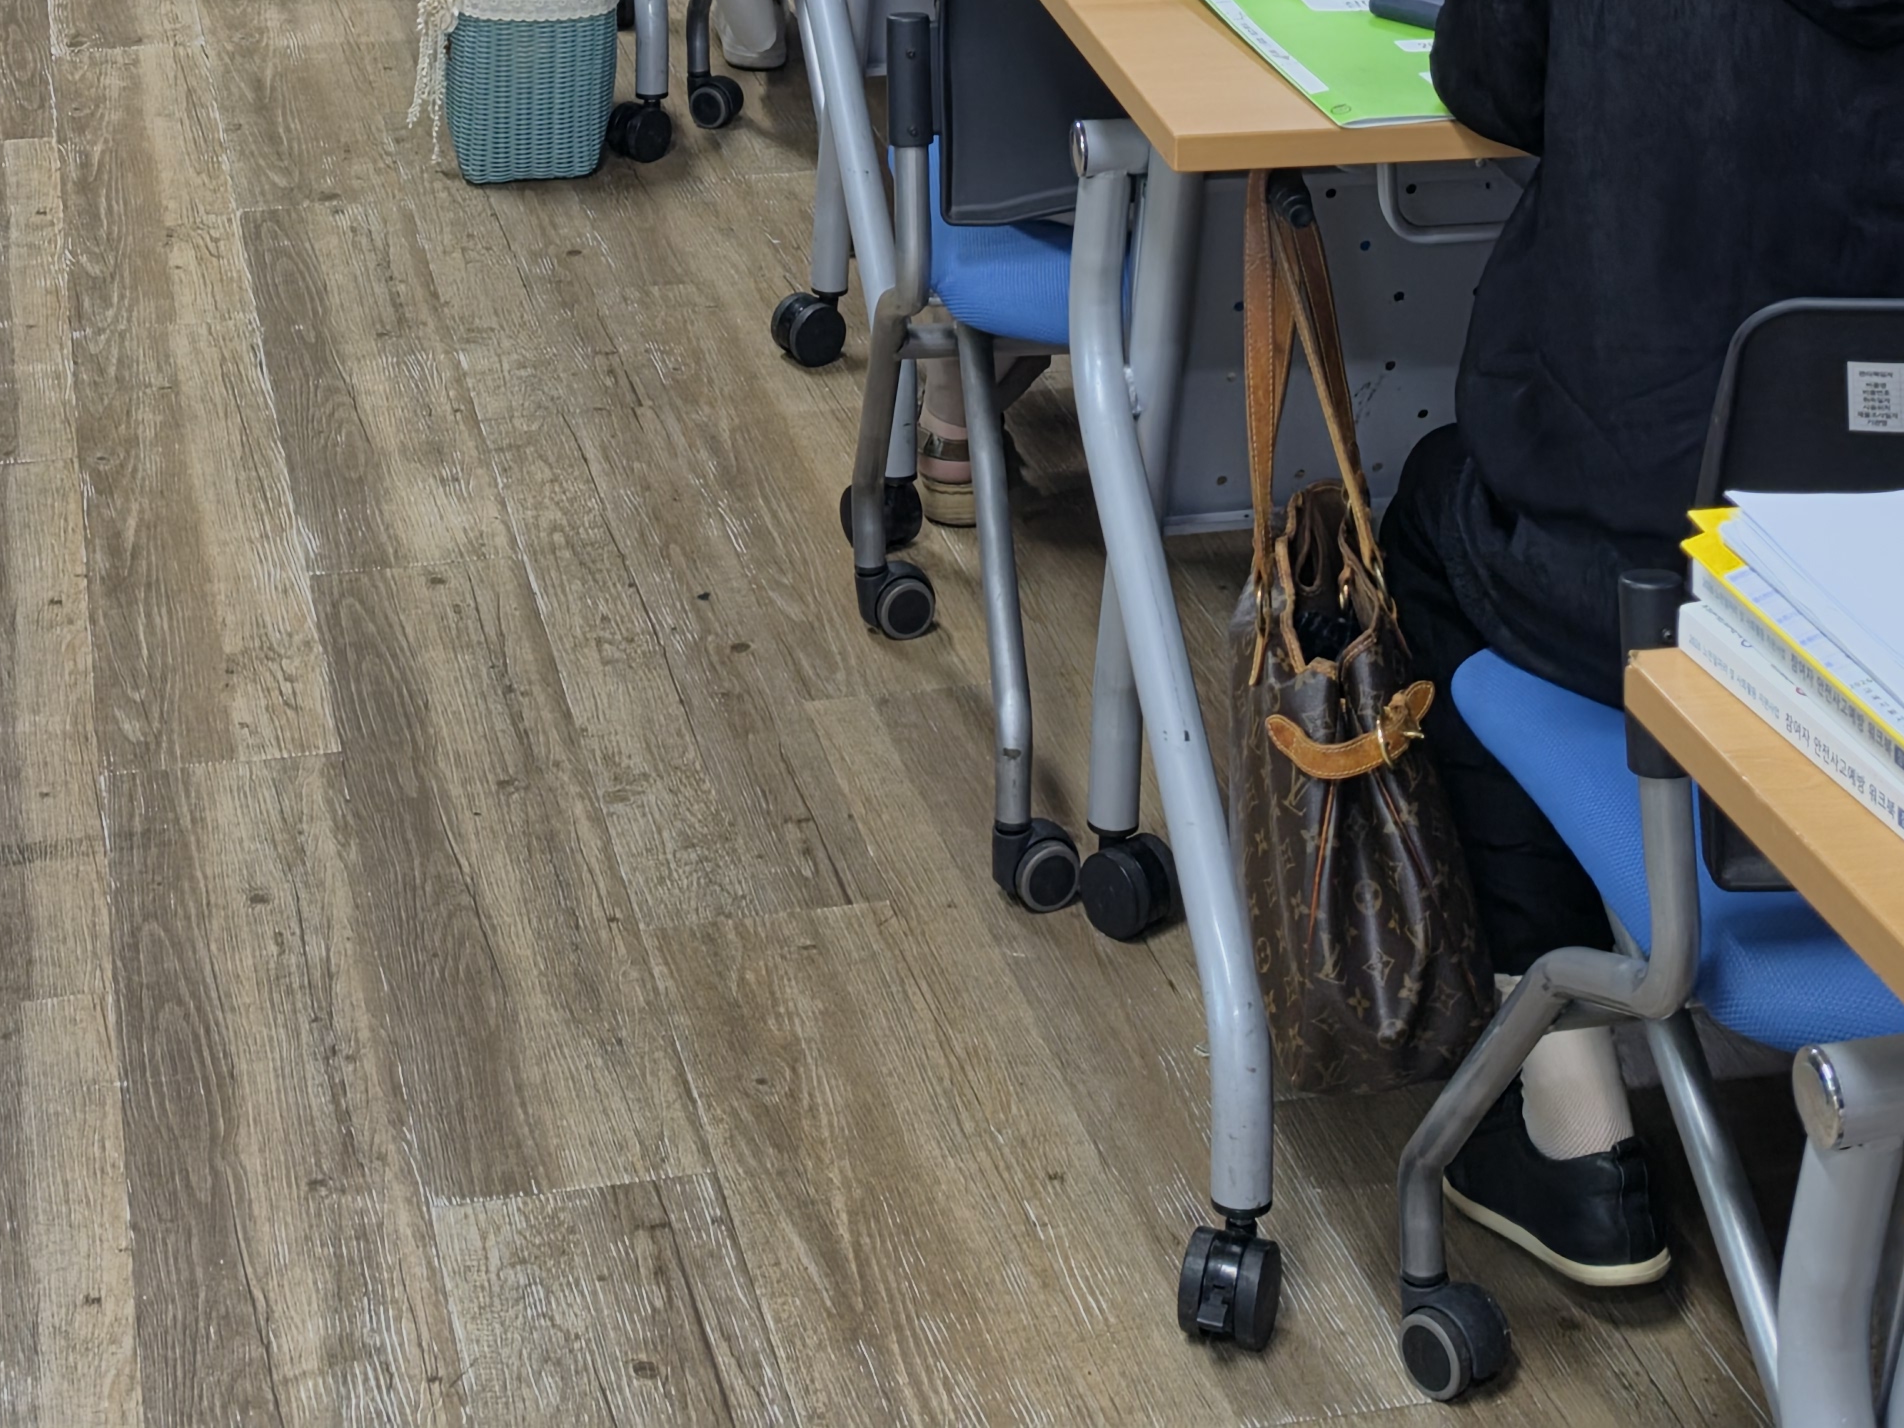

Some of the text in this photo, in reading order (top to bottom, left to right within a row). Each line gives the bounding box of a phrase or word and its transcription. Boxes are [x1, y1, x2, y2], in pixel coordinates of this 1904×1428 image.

[1790, 653, 1814, 686] 참여자
[1785, 712, 1811, 748] 참여자
[1813, 735, 1865, 794] 안전사고예방
[1869, 784, 1896, 820] 워크북
